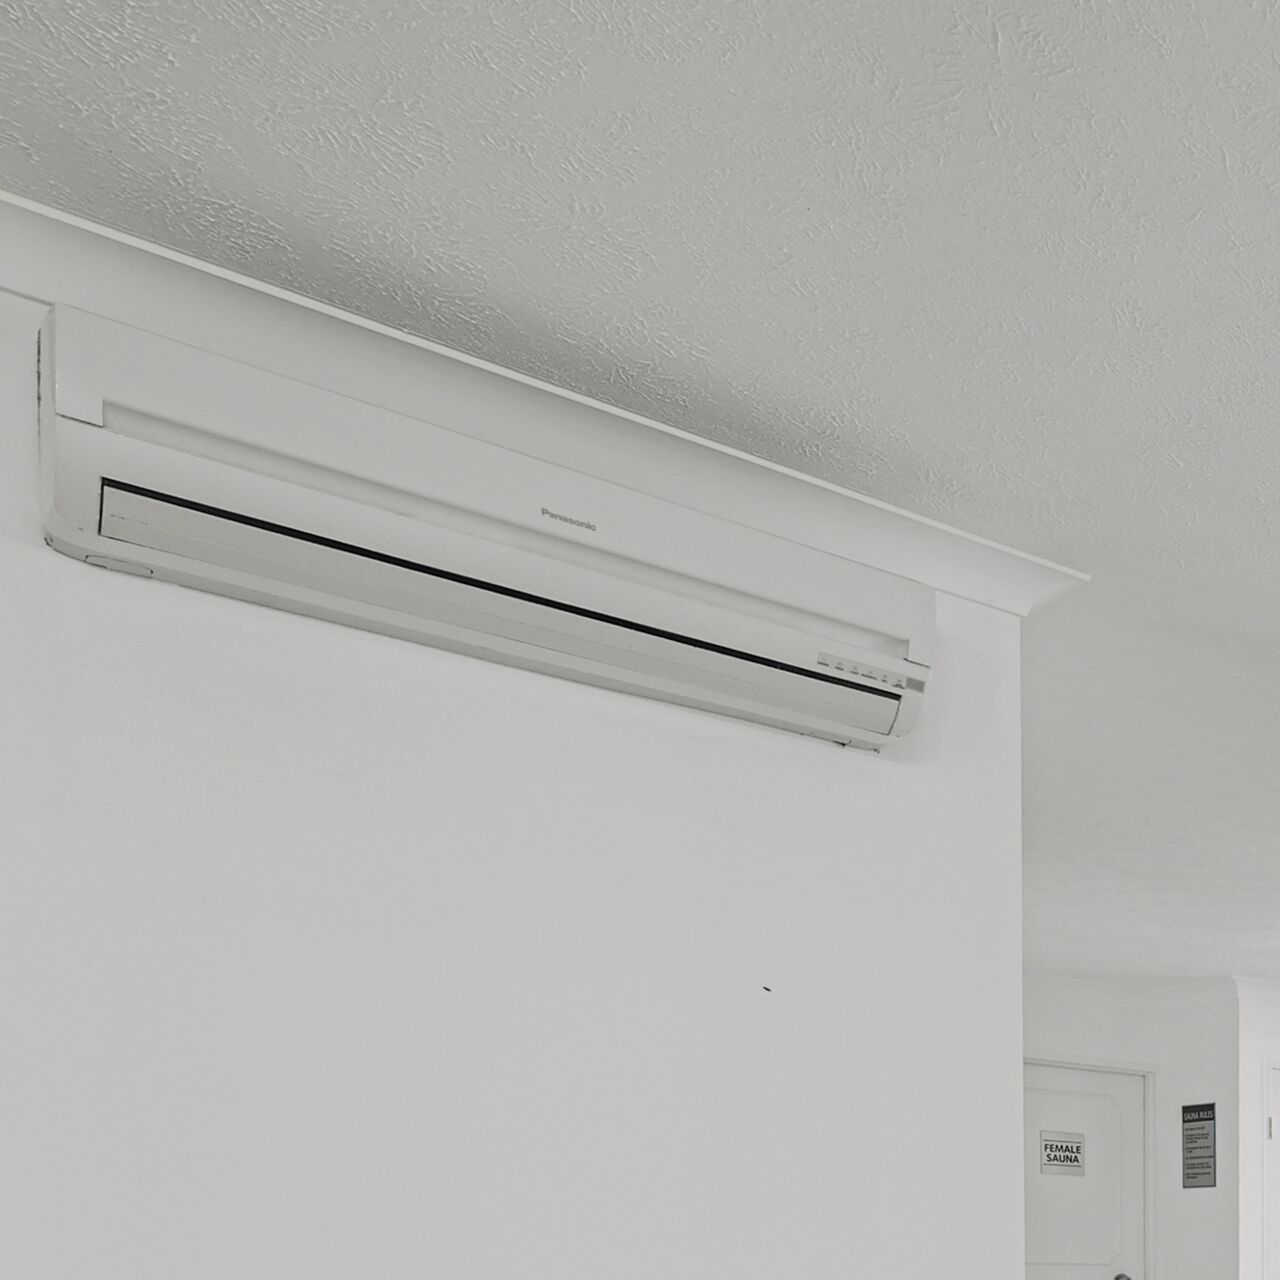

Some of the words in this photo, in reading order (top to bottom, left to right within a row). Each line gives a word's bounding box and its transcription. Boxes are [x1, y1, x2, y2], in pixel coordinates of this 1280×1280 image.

[541, 507, 597, 532] Panasonic
[1044, 1143, 1082, 1155] FEMALE
[1046, 1153, 1080, 1164] SAUNA
